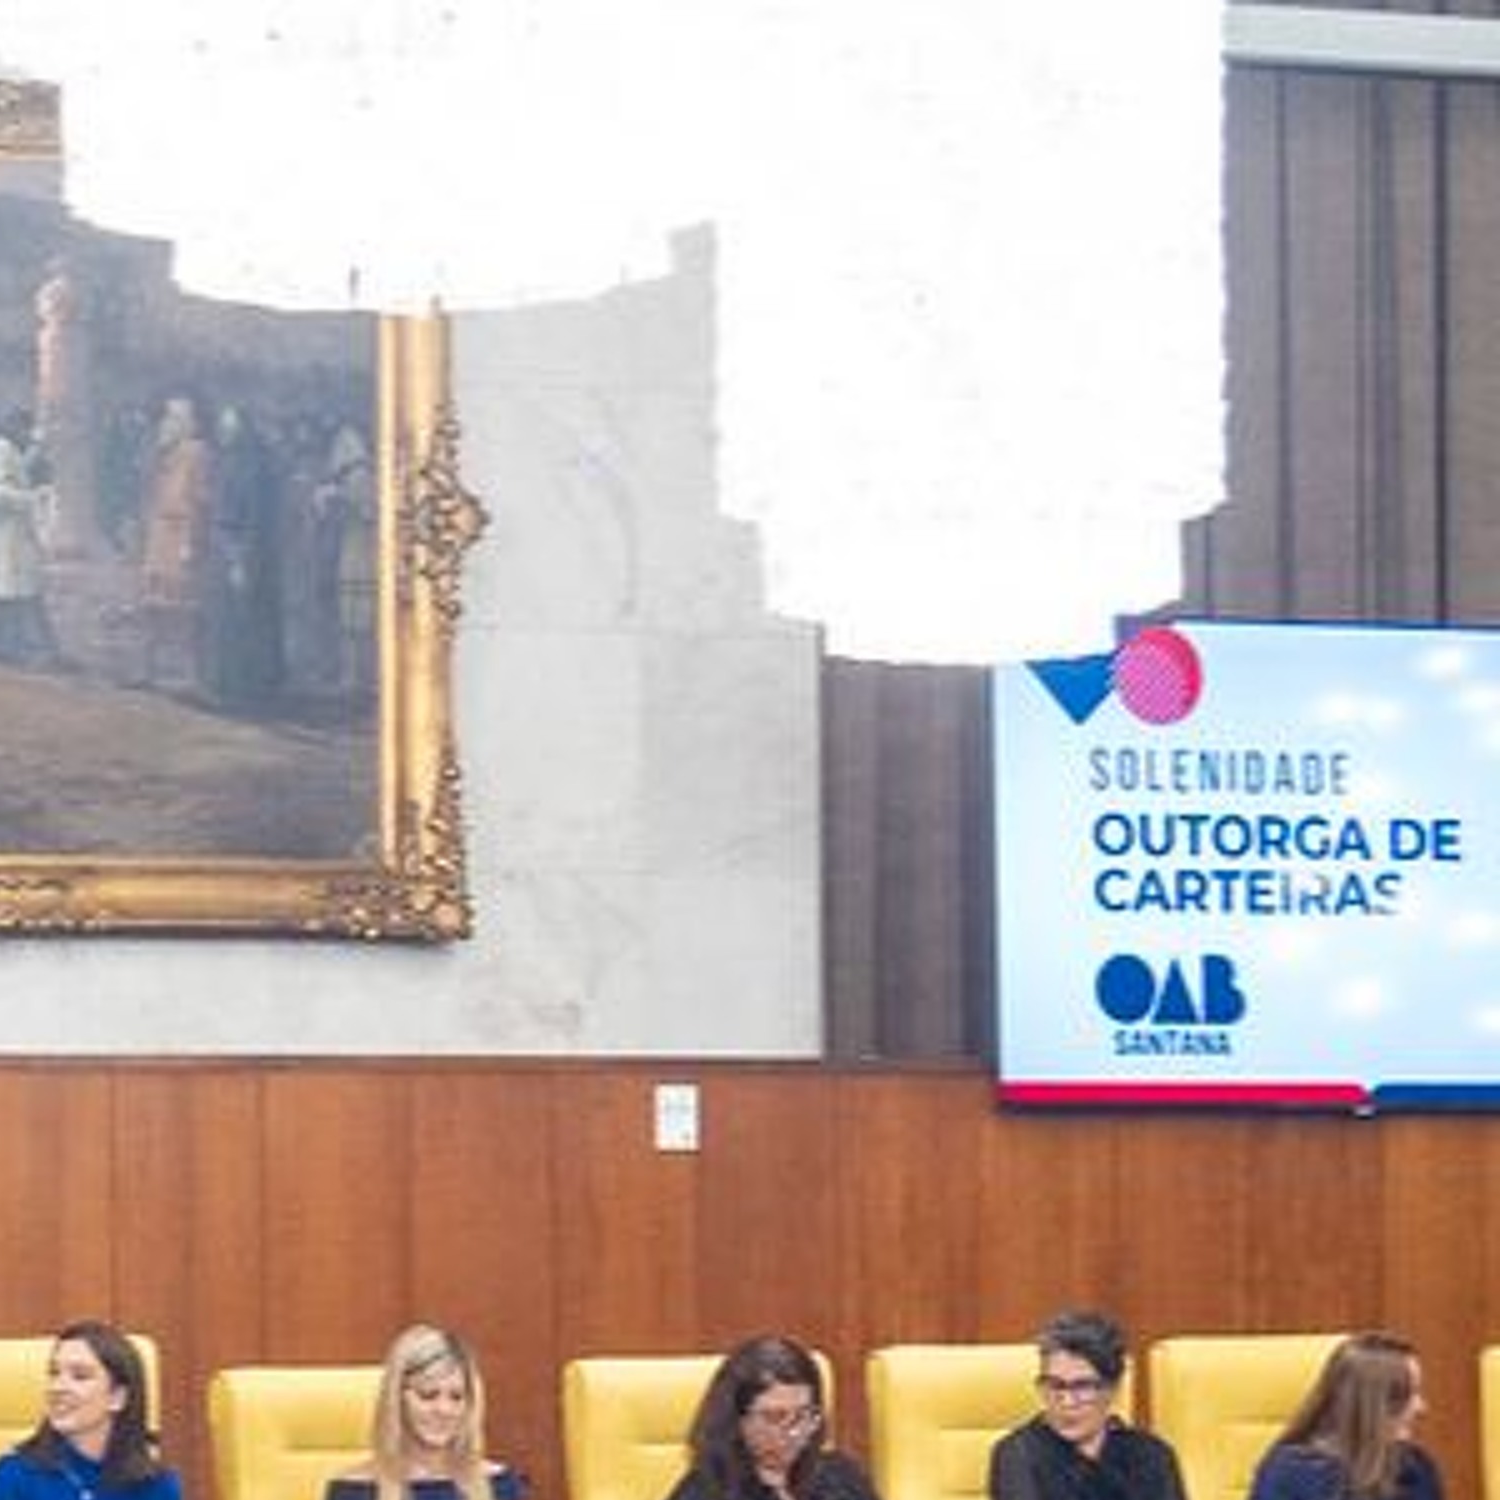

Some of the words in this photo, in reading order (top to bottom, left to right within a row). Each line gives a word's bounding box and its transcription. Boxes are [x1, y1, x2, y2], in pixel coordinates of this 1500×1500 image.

[1088, 748, 1351, 796] SOLENIDADE
[1093, 813, 1372, 861] OUTORGA
[1388, 818, 1462, 861] DE
[1094, 867, 1404, 916] CARTEIRAS
[1094, 954, 1247, 1025] OAB
[1112, 1029, 1232, 1057] SANTANA
